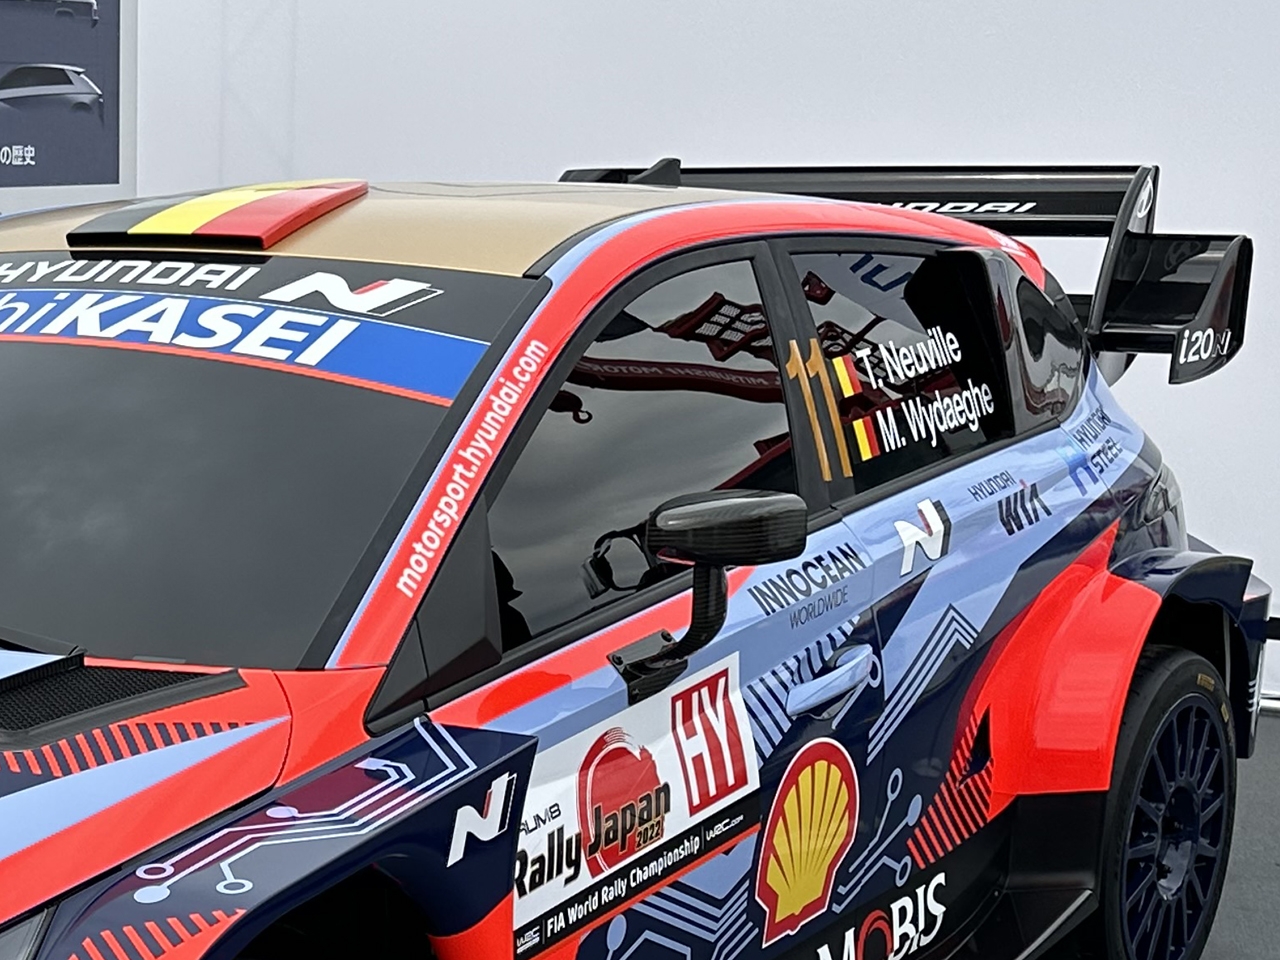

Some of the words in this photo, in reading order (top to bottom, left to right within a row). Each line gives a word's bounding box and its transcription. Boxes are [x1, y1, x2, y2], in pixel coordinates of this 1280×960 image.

[888, 202, 1037, 214] NDAI
[856, 347, 883, 390] T.
[879, 325, 962, 384] Neuville
[1179, 328, 1213, 364] i20
[785, 338, 854, 482] 11
[876, 406, 907, 453] M.
[901, 378, 995, 448] Wydaeghe
[396, 339, 549, 599] motorsport.hyundai.com
[967, 470, 1017, 503] HYUNDAI
[1089, 436, 1124, 475] STEEL
[747, 542, 868, 616] INNOCEAN
[789, 585, 849, 630] WORLDWIDE
[675, 675, 737, 808] HY
[513, 823, 582, 900] Rally
[585, 781, 671, 859] Japan
[635, 819, 661, 849] 2022
[546, 913, 566, 938] FIA
[567, 895, 599, 929] World
[601, 879, 628, 908] Rally
[629, 835, 701, 888] Championship
